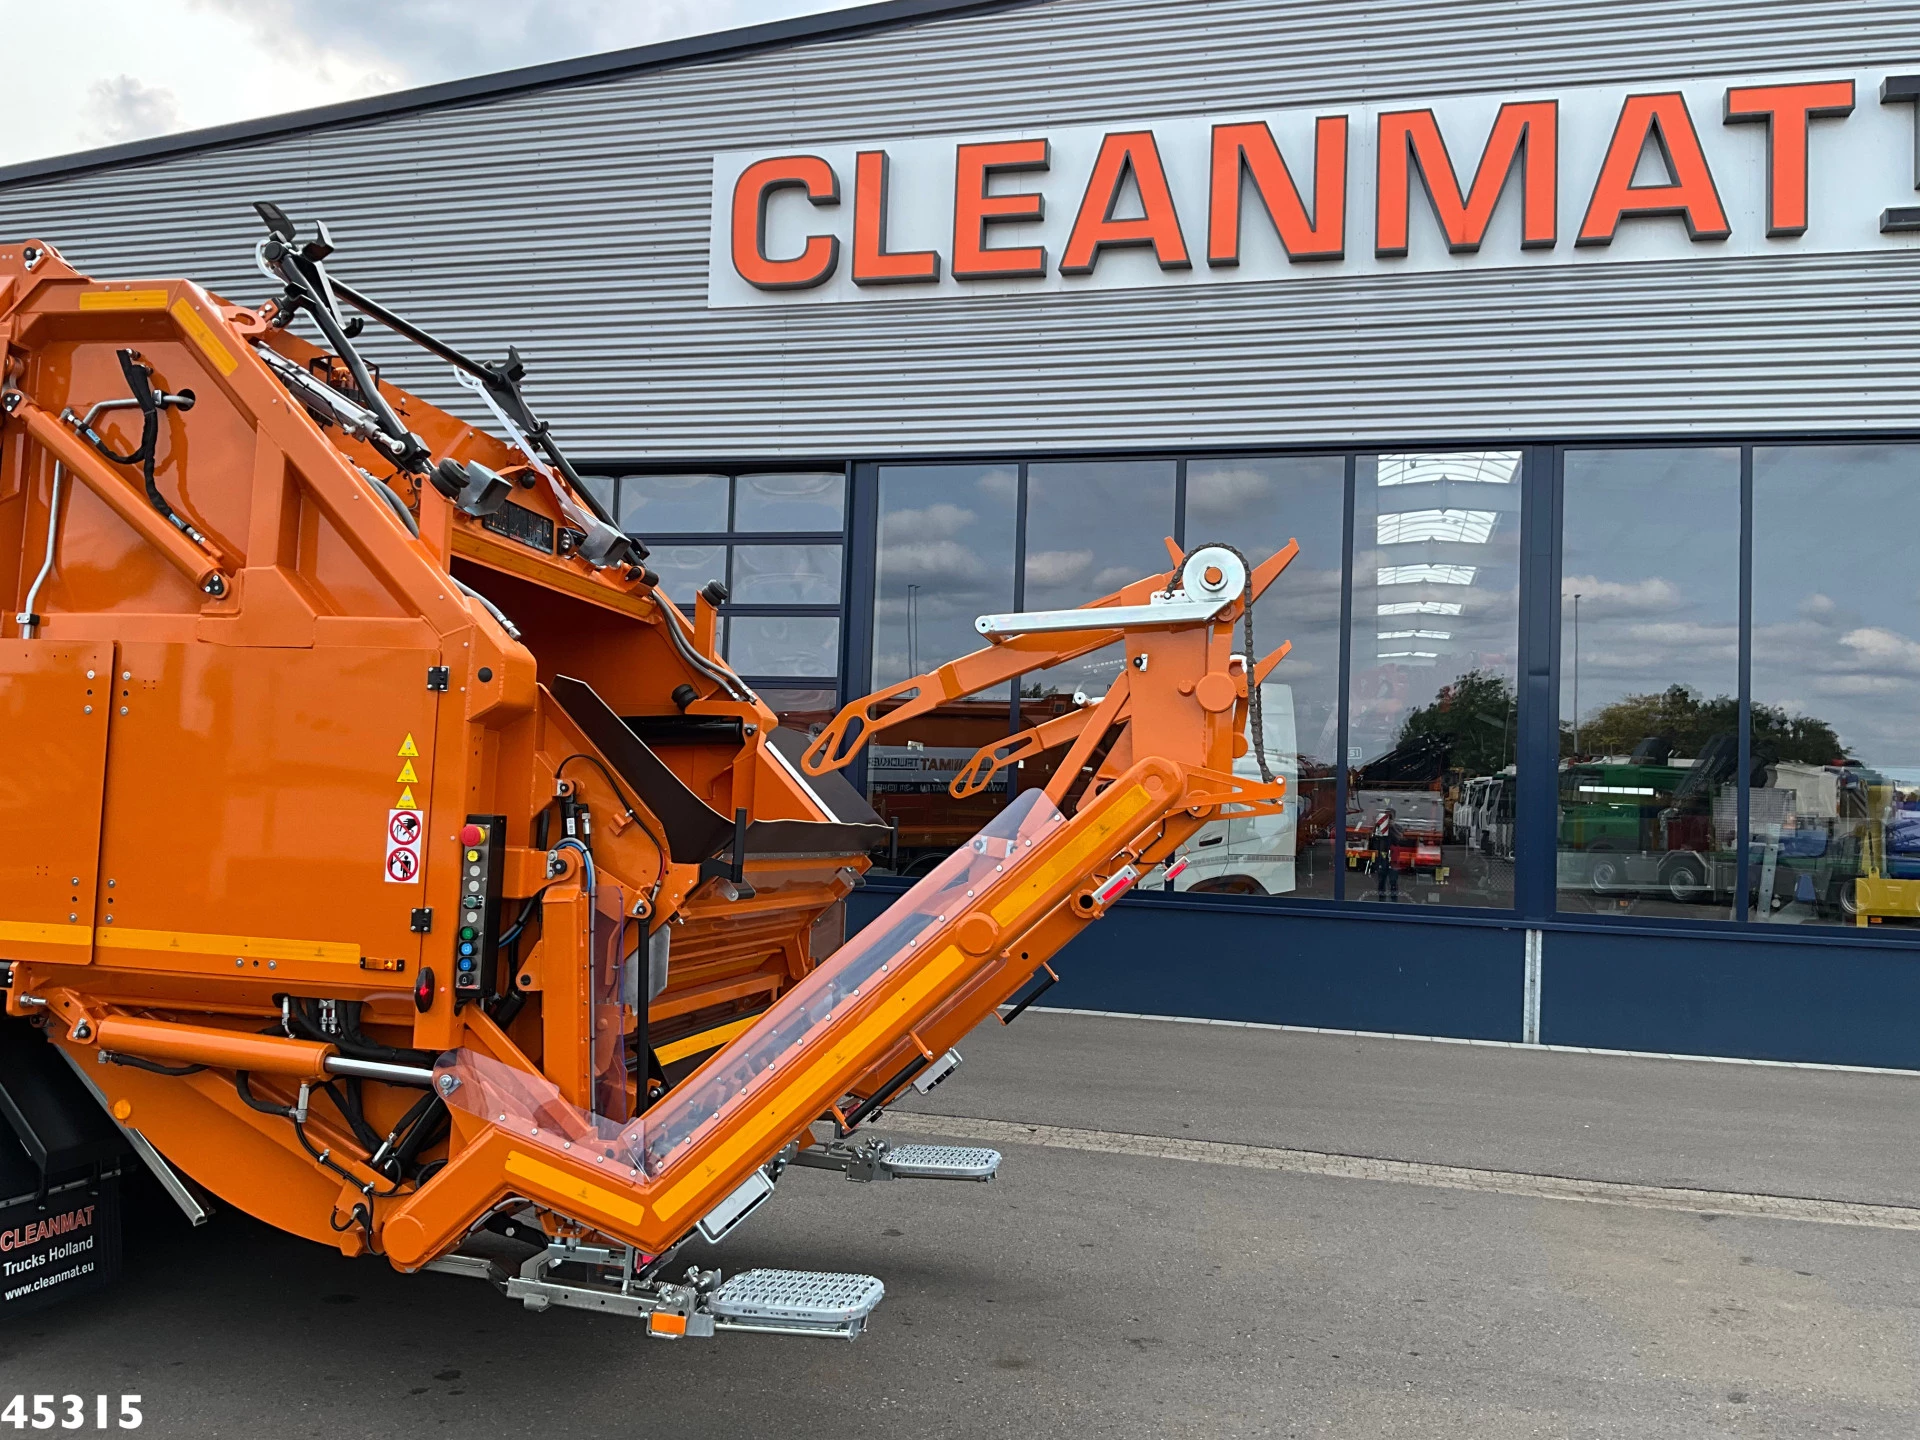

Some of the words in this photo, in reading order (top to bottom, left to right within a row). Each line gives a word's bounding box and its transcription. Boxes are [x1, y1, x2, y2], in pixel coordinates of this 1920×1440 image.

[731, 79, 1856, 291] CLEANMAT
[0, 1205, 95, 1252] CLEANMAT
[3, 1254, 46, 1276] Trucks
[49, 1235, 93, 1262] Holland
[4, 1262, 94, 1301] www.cleanmat.eu
